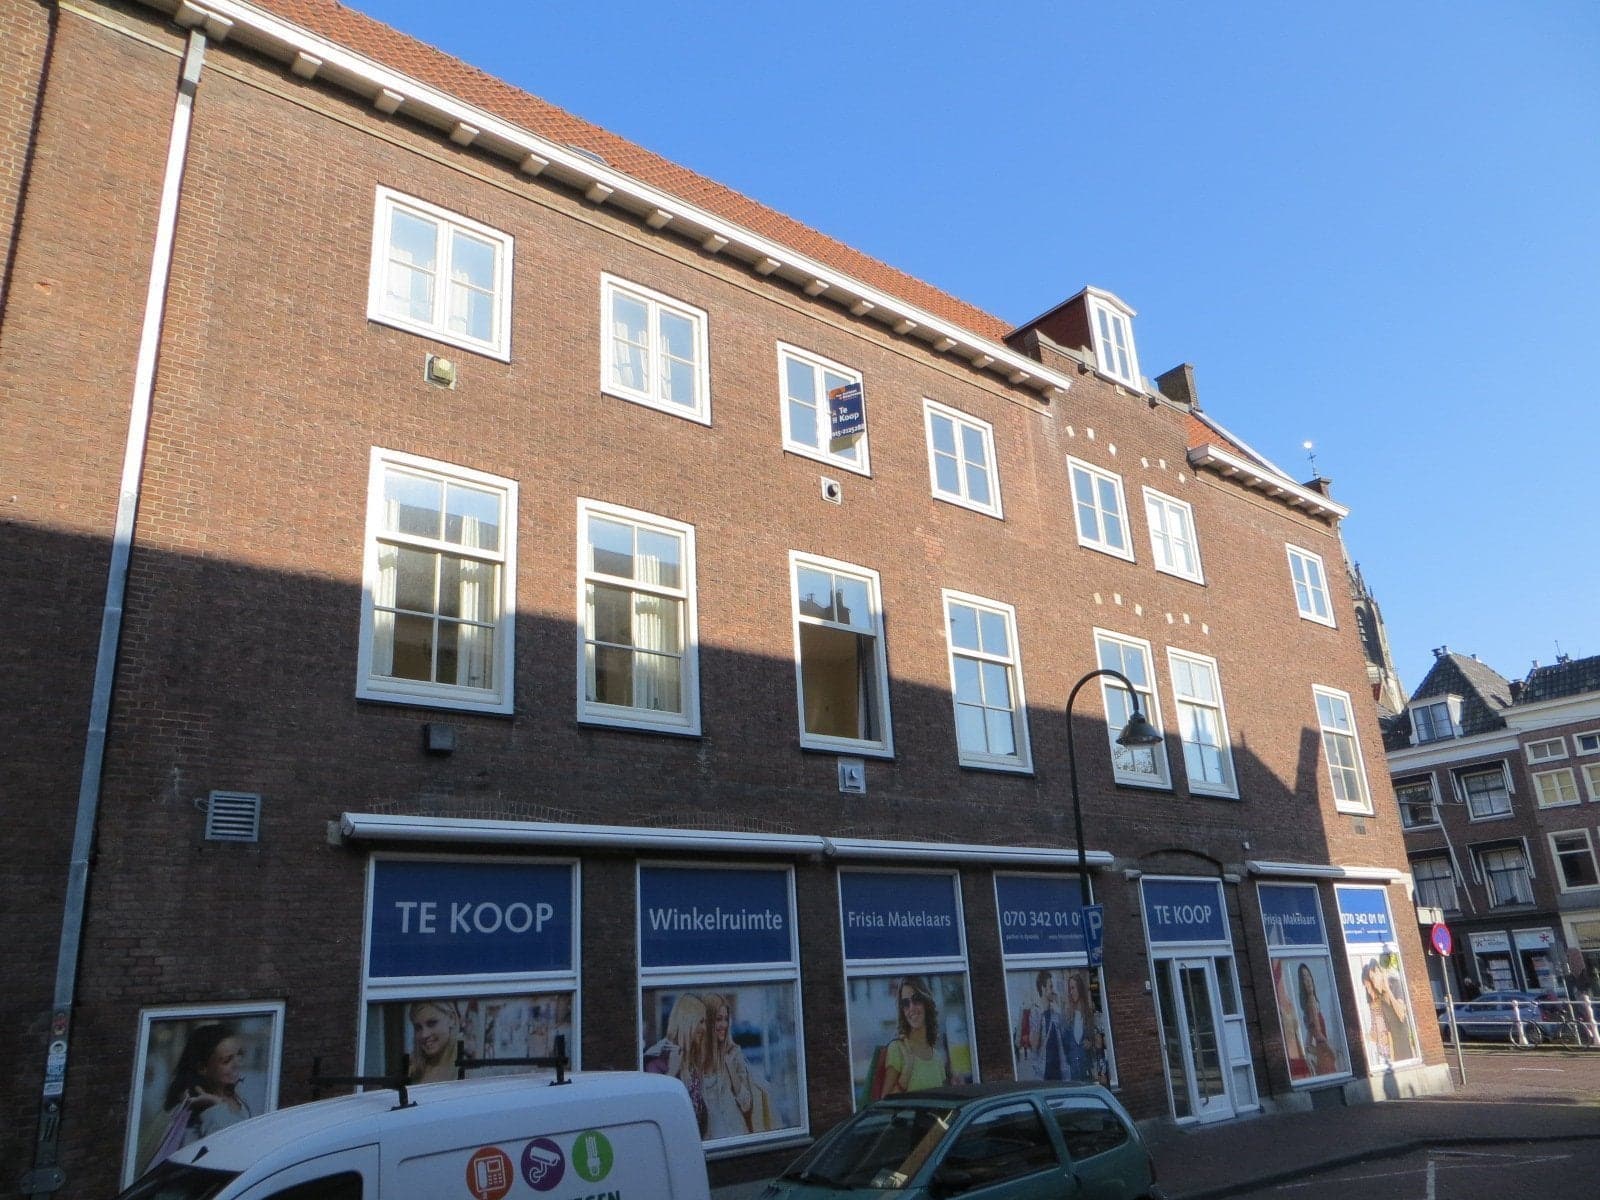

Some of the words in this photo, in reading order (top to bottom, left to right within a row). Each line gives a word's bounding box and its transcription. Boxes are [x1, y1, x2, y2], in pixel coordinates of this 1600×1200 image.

[839, 412, 859, 422] Koop
[395, 902, 437, 934] TE
[450, 902, 554, 934] KOOP
[649, 906, 783, 931] Winkelruimte
[848, 911, 885, 928] Frisia
[888, 910, 951, 927] Makelaars
[1003, 911, 1027, 926] 070
[1030, 911, 1052, 926] 342
[1055, 912, 1068, 926] 01
[1153, 905, 1171, 924] TE
[1173, 905, 1212, 924] KOOP
[1283, 912, 1316, 925] Makelaars
[1341, 912, 1355, 925] 070
[1355, 912, 1369, 925] 342
[1369, 912, 1377, 925] 01
[1378, 912, 1386, 925] 01
[1089, 911, 1102, 939] P
